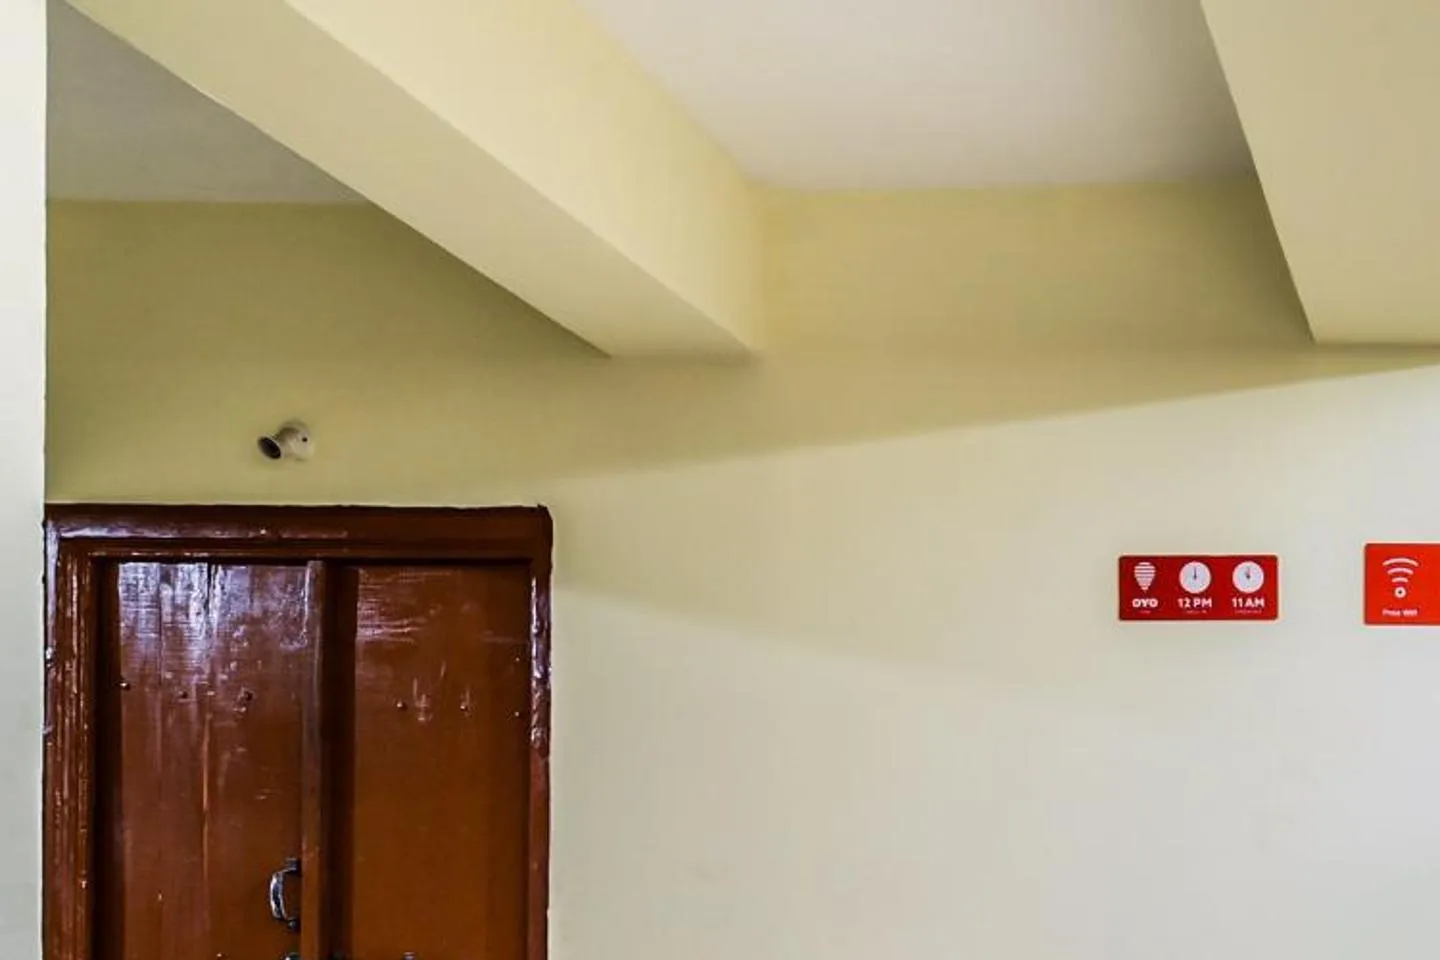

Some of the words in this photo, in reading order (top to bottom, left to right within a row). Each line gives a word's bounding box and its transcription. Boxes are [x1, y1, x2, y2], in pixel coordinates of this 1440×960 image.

[1131, 598, 1158, 608] OYO
[1178, 598, 1191, 608] 12
[1193, 598, 1212, 608] PM
[1232, 598, 1242, 608] 11
[1244, 598, 1265, 608] AM
